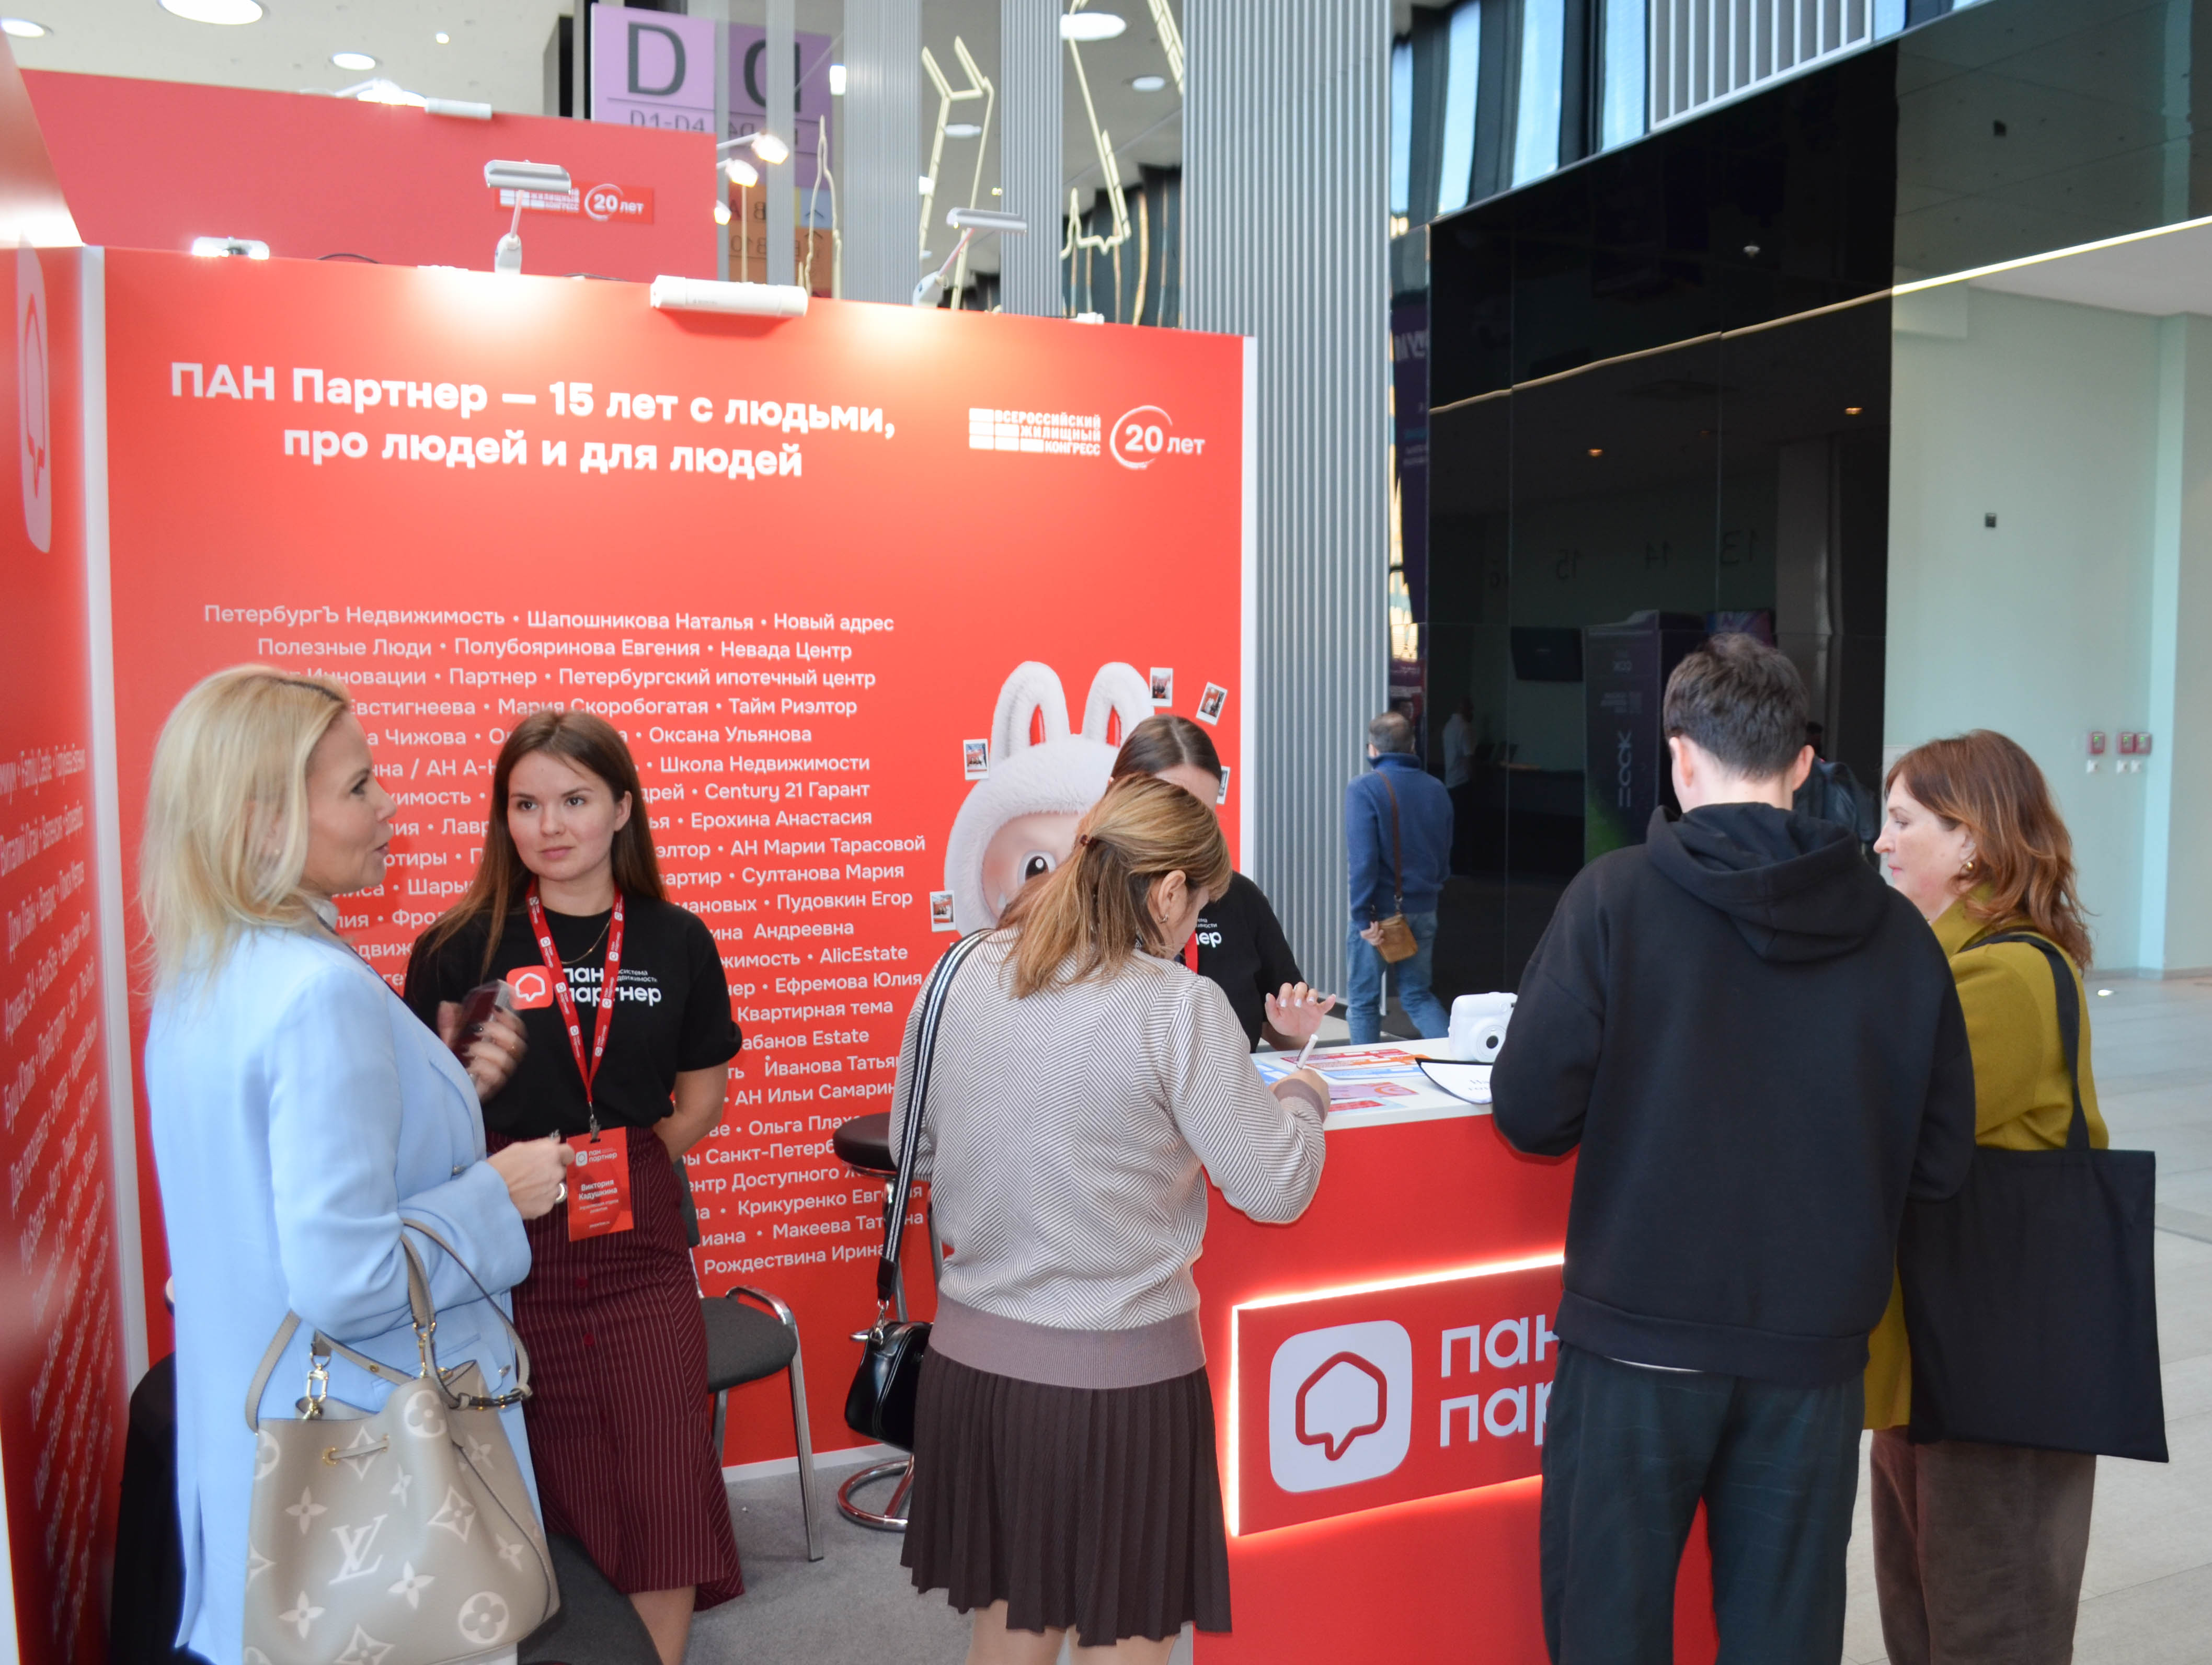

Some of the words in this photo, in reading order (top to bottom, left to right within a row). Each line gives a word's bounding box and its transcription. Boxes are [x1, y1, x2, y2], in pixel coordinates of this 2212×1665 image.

[628, 21, 686, 96] D
[593, 194, 618, 211] 20
[620, 201, 644, 214] лет
[172, 362, 274, 400] ПАН
[293, 368, 487, 418] Партнер
[549, 382, 593, 416] 15
[606, 393, 678, 420] лет
[691, 397, 713, 423] с
[725, 400, 895, 439] людьми,
[994, 409, 1101, 429] ВСЕРОССИЙСКИЙ
[1021, 425, 1101, 442] ЖИЛИЩНЫЙ
[1125, 424, 1163, 453] 20
[1167, 436, 1205, 455] лет
[284, 430, 368, 465] про
[382, 429, 526, 469] людей
[542, 440, 566, 466] и
[580, 442, 657, 474] для
[670, 443, 801, 480] людей
[1045, 440, 1101, 456] КОНГРЕСС
[205, 605, 339, 628] ПетербургЪ
[347, 607, 505, 626] Недвижимость
[528, 611, 669, 629] Шапошникова
[676, 613, 753, 630] Наталья
[775, 613, 834, 630] Новый
[840, 618, 893, 633] адрес
[259, 638, 366, 655] Полезные
[373, 639, 431, 658] Люди
[455, 638, 615, 658] Полубояринова
[622, 640, 700, 656] Евгения
[721, 641, 790, 660] Невада
[797, 642, 852, 662] Центр
[308, 668, 426, 688] Иновации
[450, 668, 537, 688] Партнер
[560, 668, 709, 689] Петербургский
[716, 669, 817, 685] ипотечный
[823, 674, 875, 689] центр
[499, 699, 564, 715] Мария
[571, 698, 708, 717] Скоробогатая
[729, 698, 775, 714] Тайм
[782, 698, 857, 717] Риэлтор
[386, 729, 466, 745] Чижова
[649, 727, 719, 743] Оксана
[725, 726, 811, 742] Ульянова
[427, 760, 456, 776] АН
[661, 757, 724, 772] Школа
[730, 756, 869, 774] Недвижимости
[391, 792, 471, 805] имость
[705, 783, 779, 802] Century
[785, 782, 801, 797] 21
[809, 782, 870, 800] Гарант
[442, 818, 489, 837] Лавр
[692, 813, 770, 831] Ерохина
[776, 811, 872, 826] Анастасия
[656, 845, 710, 860] элтор
[731, 840, 757, 856] АН
[764, 839, 825, 858] Марии
[830, 835, 925, 856] Тарасовой
[408, 879, 473, 898] Шары
[661, 871, 721, 888] артир
[742, 868, 840, 886] Султанова
[846, 864, 903, 882] Мария
[338, 915, 369, 928] лия
[777, 894, 866, 913] Пудовкин
[872, 891, 913, 908] Егор
[709, 928, 742, 940] ина
[754, 923, 854, 940] Андреевна
[720, 954, 800, 968] жимость
[820, 946, 908, 963] AlicEstate
[776, 977, 867, 995] Ефремова
[874, 972, 922, 987] Юлия
[738, 1004, 845, 1023] Квартирная
[850, 1001, 892, 1014] тема
[742, 1034, 807, 1050] абанов
[813, 1029, 869, 1045] Estate
[765, 1060, 842, 1077] Иванова
[847, 1056, 898, 1070] Татья
[735, 1089, 761, 1105] АН
[769, 1088, 813, 1103] Ильи
[819, 1083, 895, 1099] Самарин
[749, 1121, 802, 1135] Ольга
[589, 1152, 617, 1163] партнер
[706, 1139, 834, 1164] Санкт-Петерб
[581, 1180, 614, 1191] Виктория
[732, 1168, 839, 1192] Доступного
[739, 1194, 846, 1217] Крикуренко
[698, 1231, 746, 1247] иана
[773, 1221, 850, 1238] Макеева
[705, 1251, 826, 1274] Рождествина
